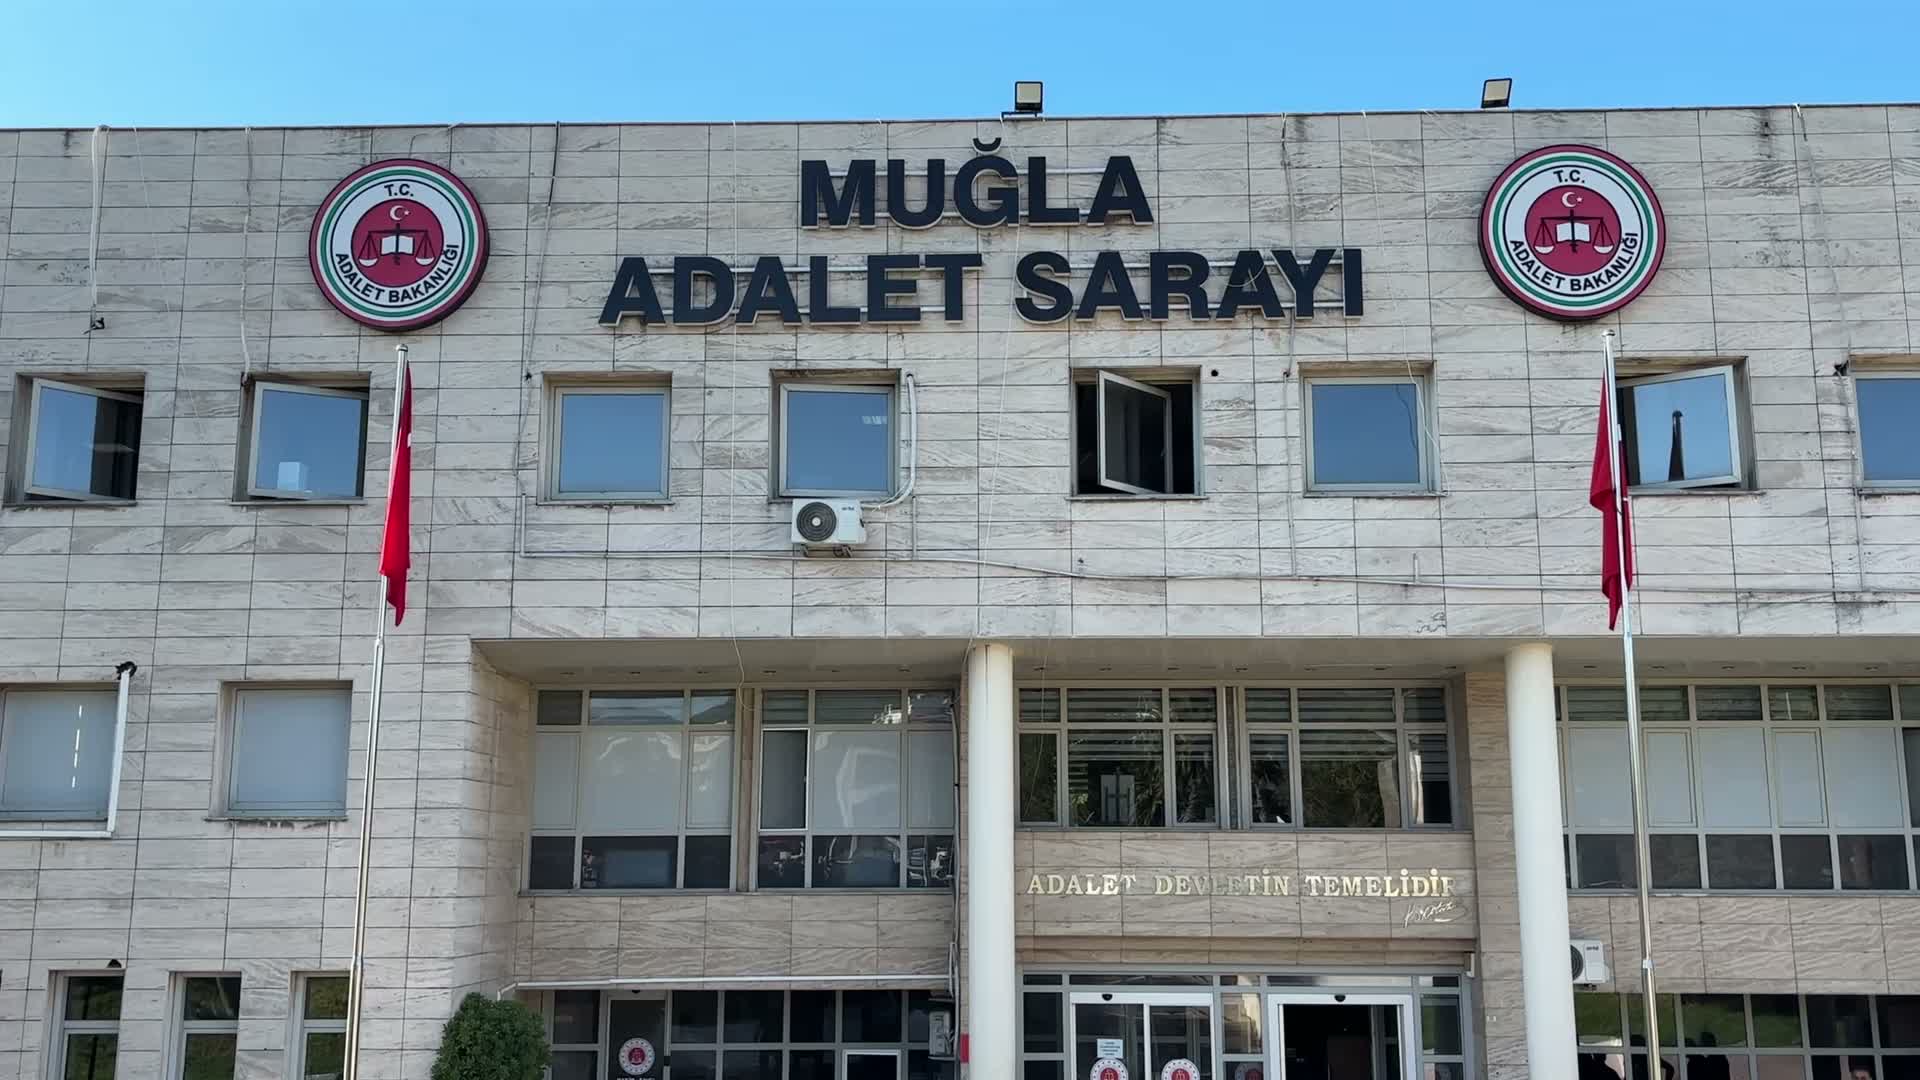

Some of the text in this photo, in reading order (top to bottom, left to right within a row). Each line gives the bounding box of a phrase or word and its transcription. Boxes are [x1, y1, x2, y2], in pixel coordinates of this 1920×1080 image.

[384, 183, 414, 197] T.C.
[801, 137, 1153, 229] MUĞLA
[1553, 169, 1585, 183] T.C.
[335, 244, 459, 303] ADALET BAKANLIĞI
[600, 248, 1363, 326] ADALET SARAYI
[1509, 232, 1638, 292] ADALET BAKANLIĞI
[1027, 868, 1456, 897] ADALET DEVLETİN TEMELİDİR
